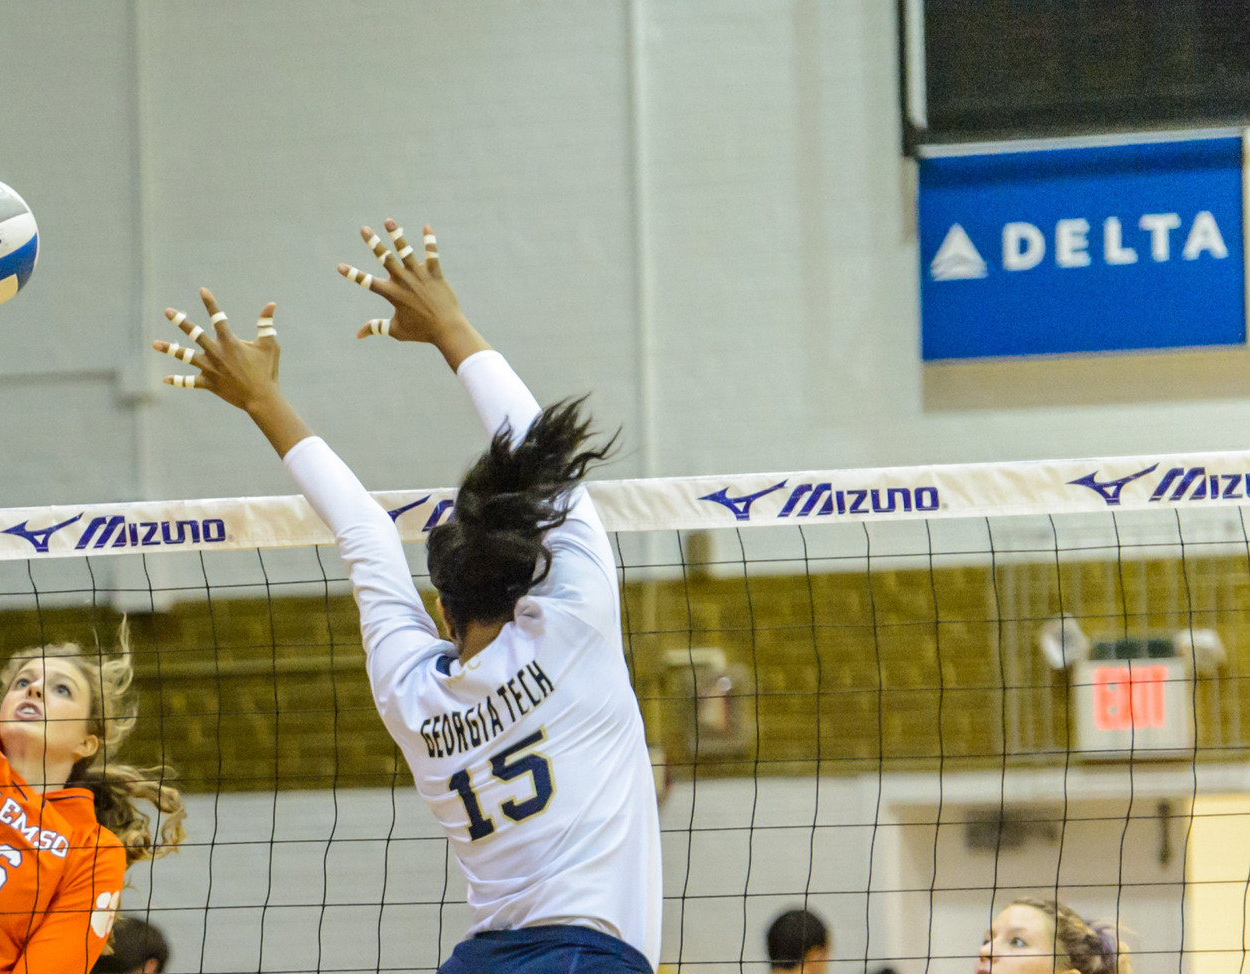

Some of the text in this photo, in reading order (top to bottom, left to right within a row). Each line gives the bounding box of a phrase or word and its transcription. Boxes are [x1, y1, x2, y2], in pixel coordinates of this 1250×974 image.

[1002, 210, 1228, 271] DELTA
[777, 482, 940, 518] MIZUNO
[75, 514, 227, 549] MIZUNO
[420, 660, 555, 758] GEORGIA TECH
[449, 723, 558, 842] 15
